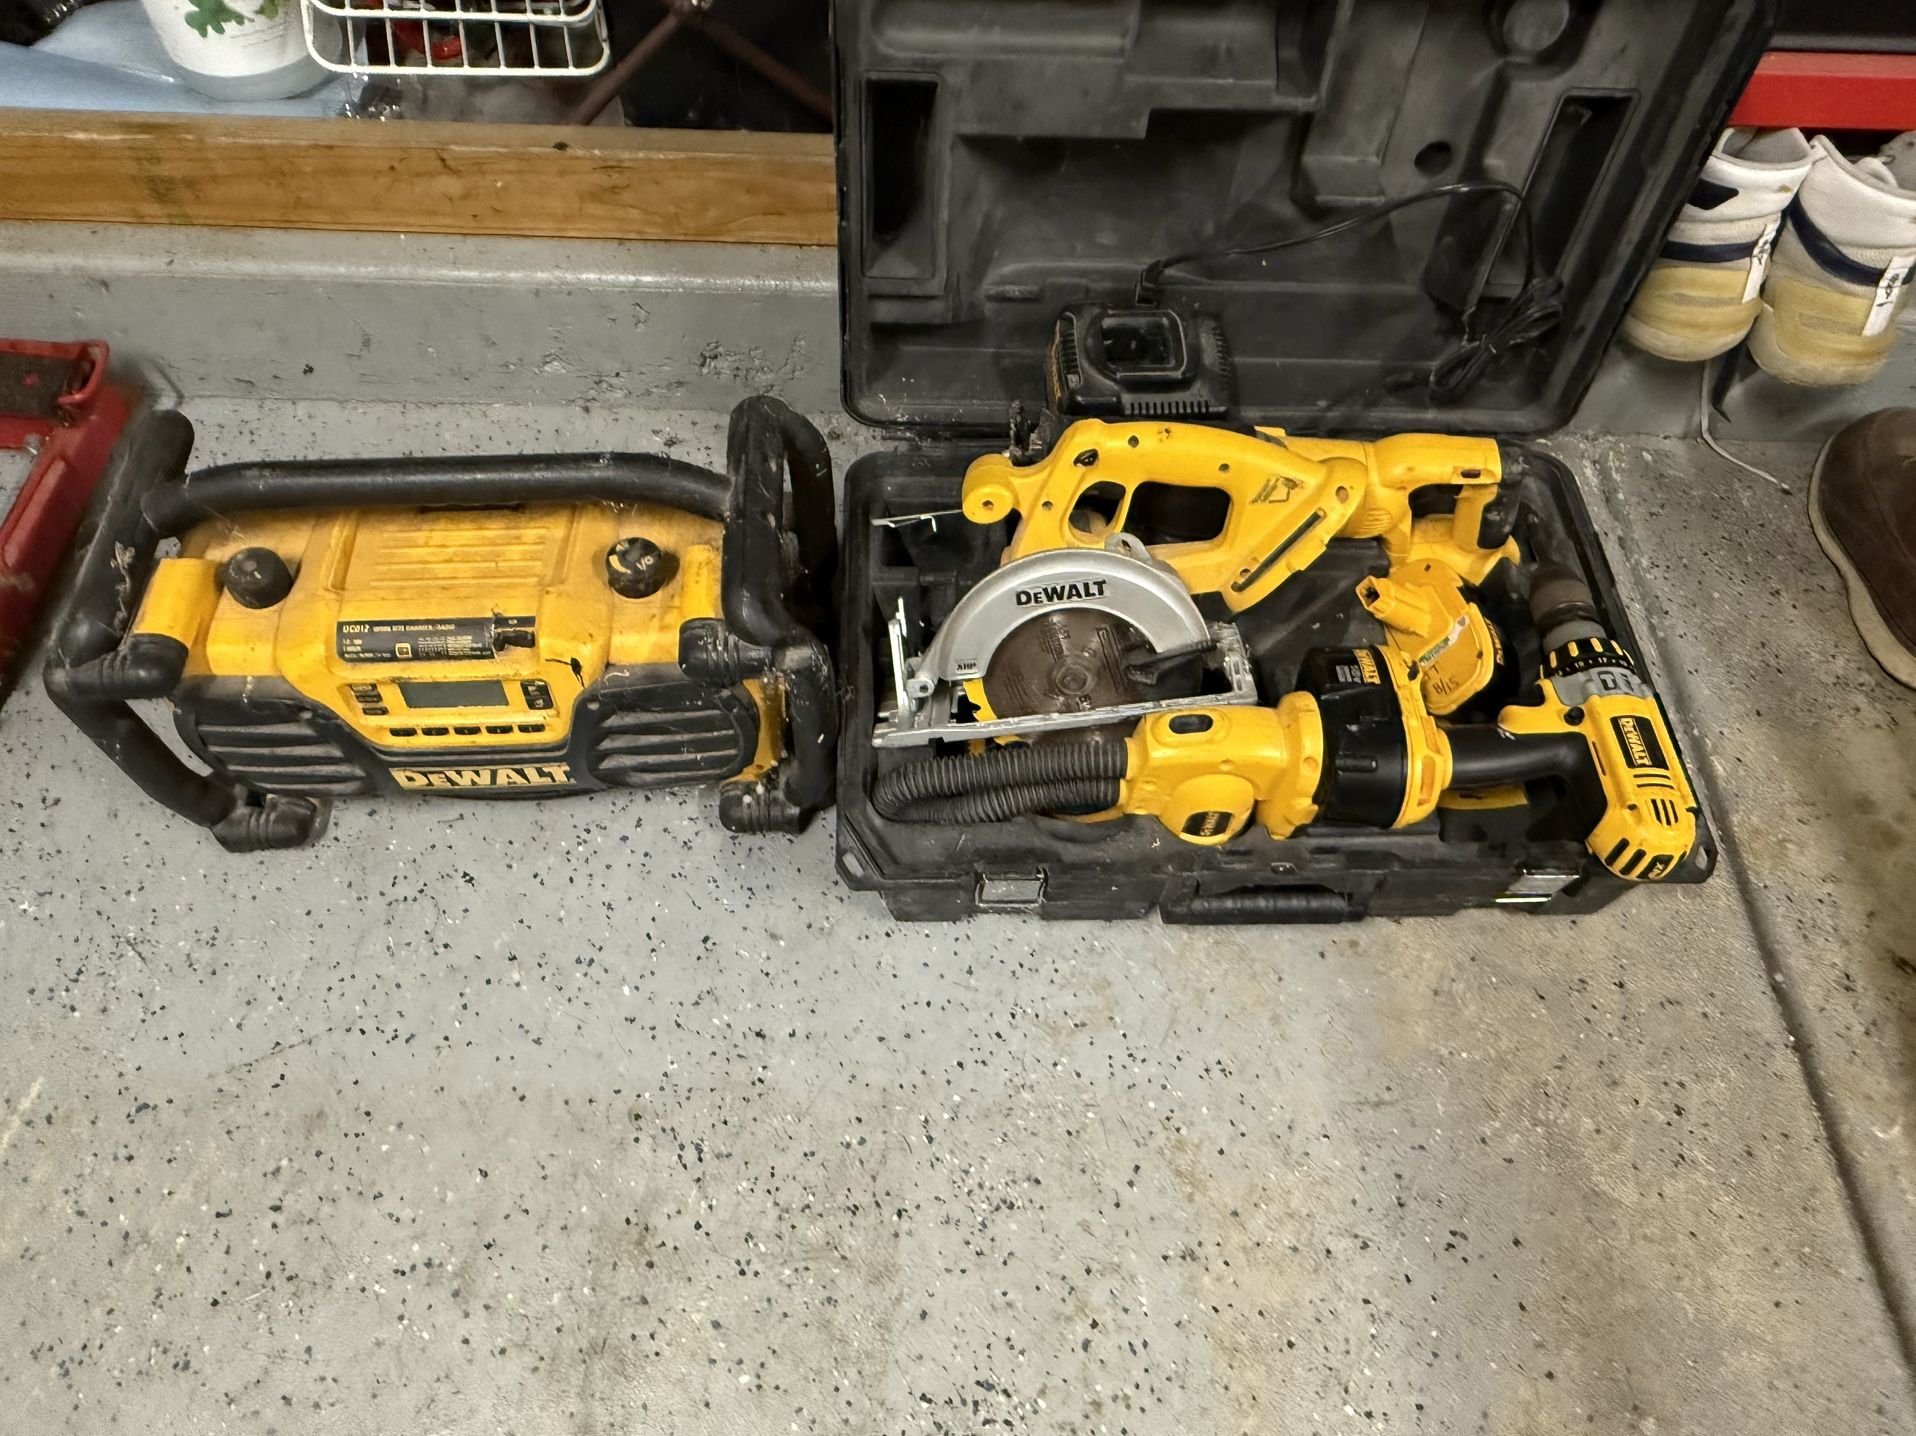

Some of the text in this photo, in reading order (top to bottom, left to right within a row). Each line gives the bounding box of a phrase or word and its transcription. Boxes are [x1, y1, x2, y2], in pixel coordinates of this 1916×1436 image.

[1015, 579, 1107, 606] DEWALT
[1618, 717, 1652, 767] DEWALT
[389, 764, 571, 789] DEWALT
